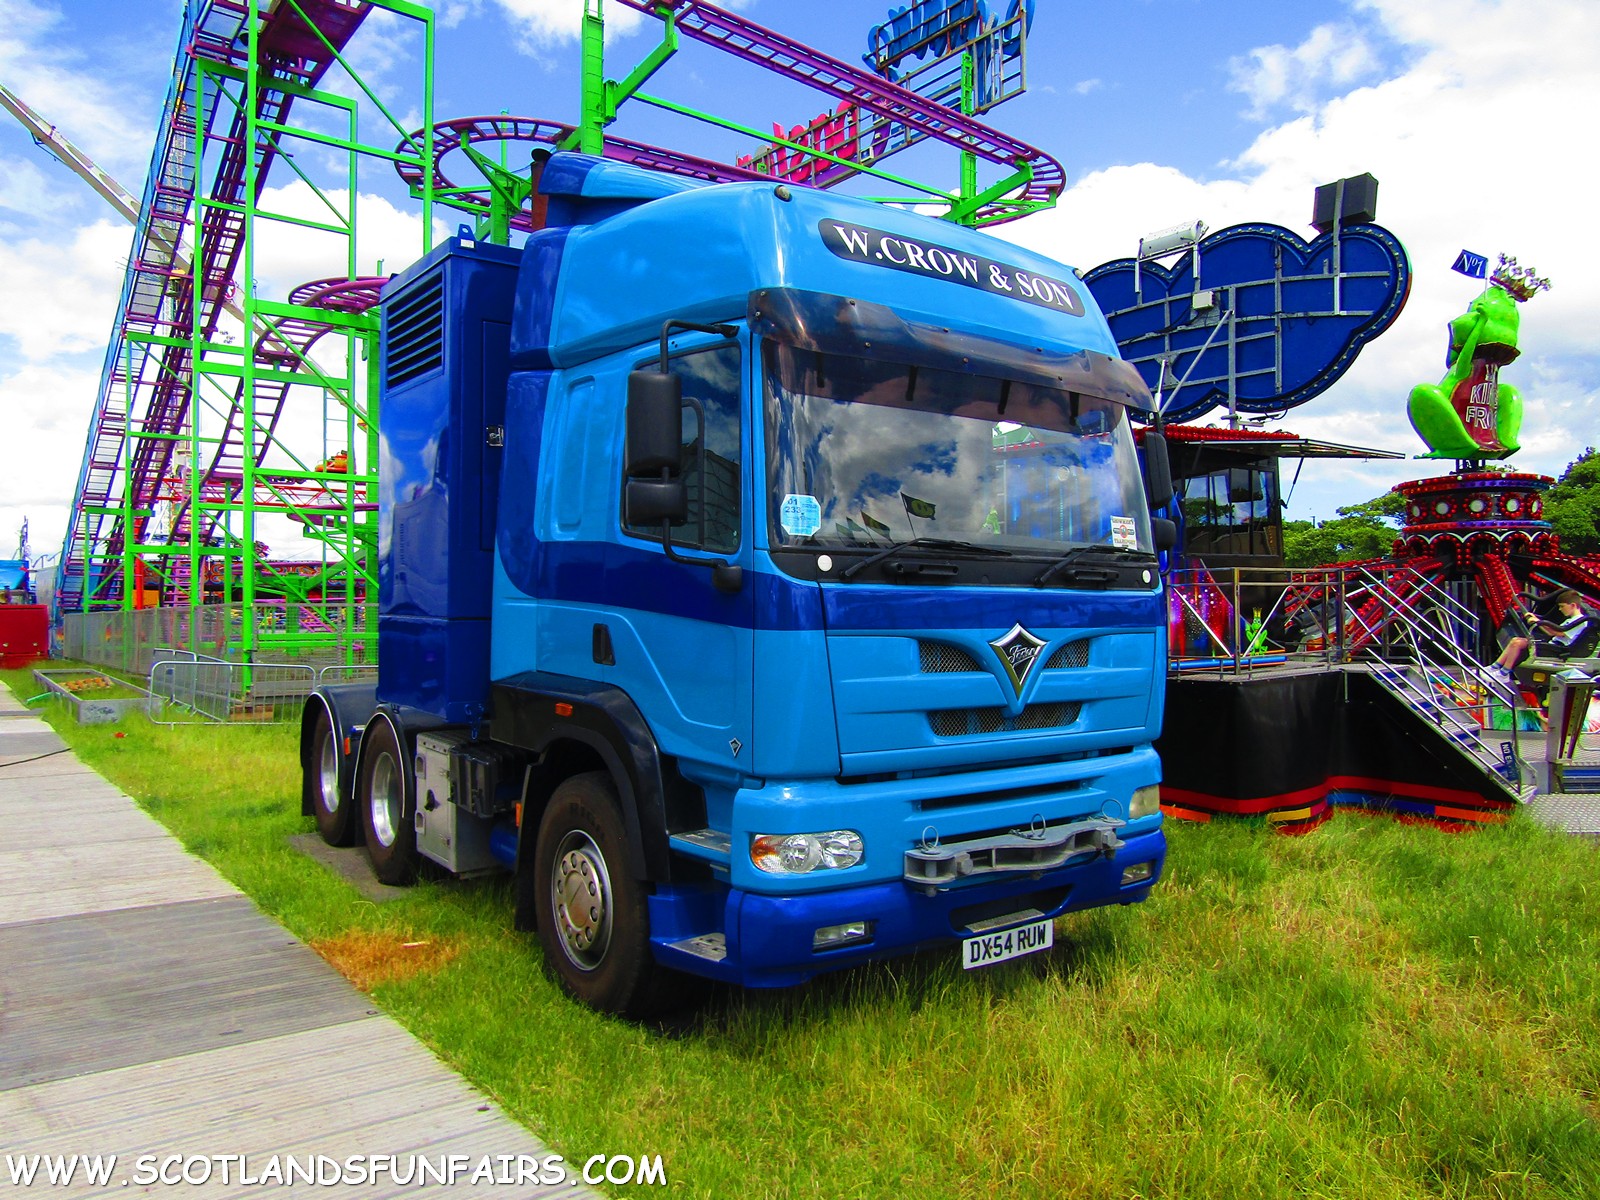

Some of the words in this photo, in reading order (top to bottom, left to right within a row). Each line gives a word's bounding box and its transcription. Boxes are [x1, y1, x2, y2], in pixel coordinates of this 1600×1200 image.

[989, 264, 1012, 292] &
[1015, 272, 1074, 309] SON
[1502, 744, 1510, 753] NO
[970, 932, 1013, 963] DX54
[1017, 923, 1046, 951] RUW
